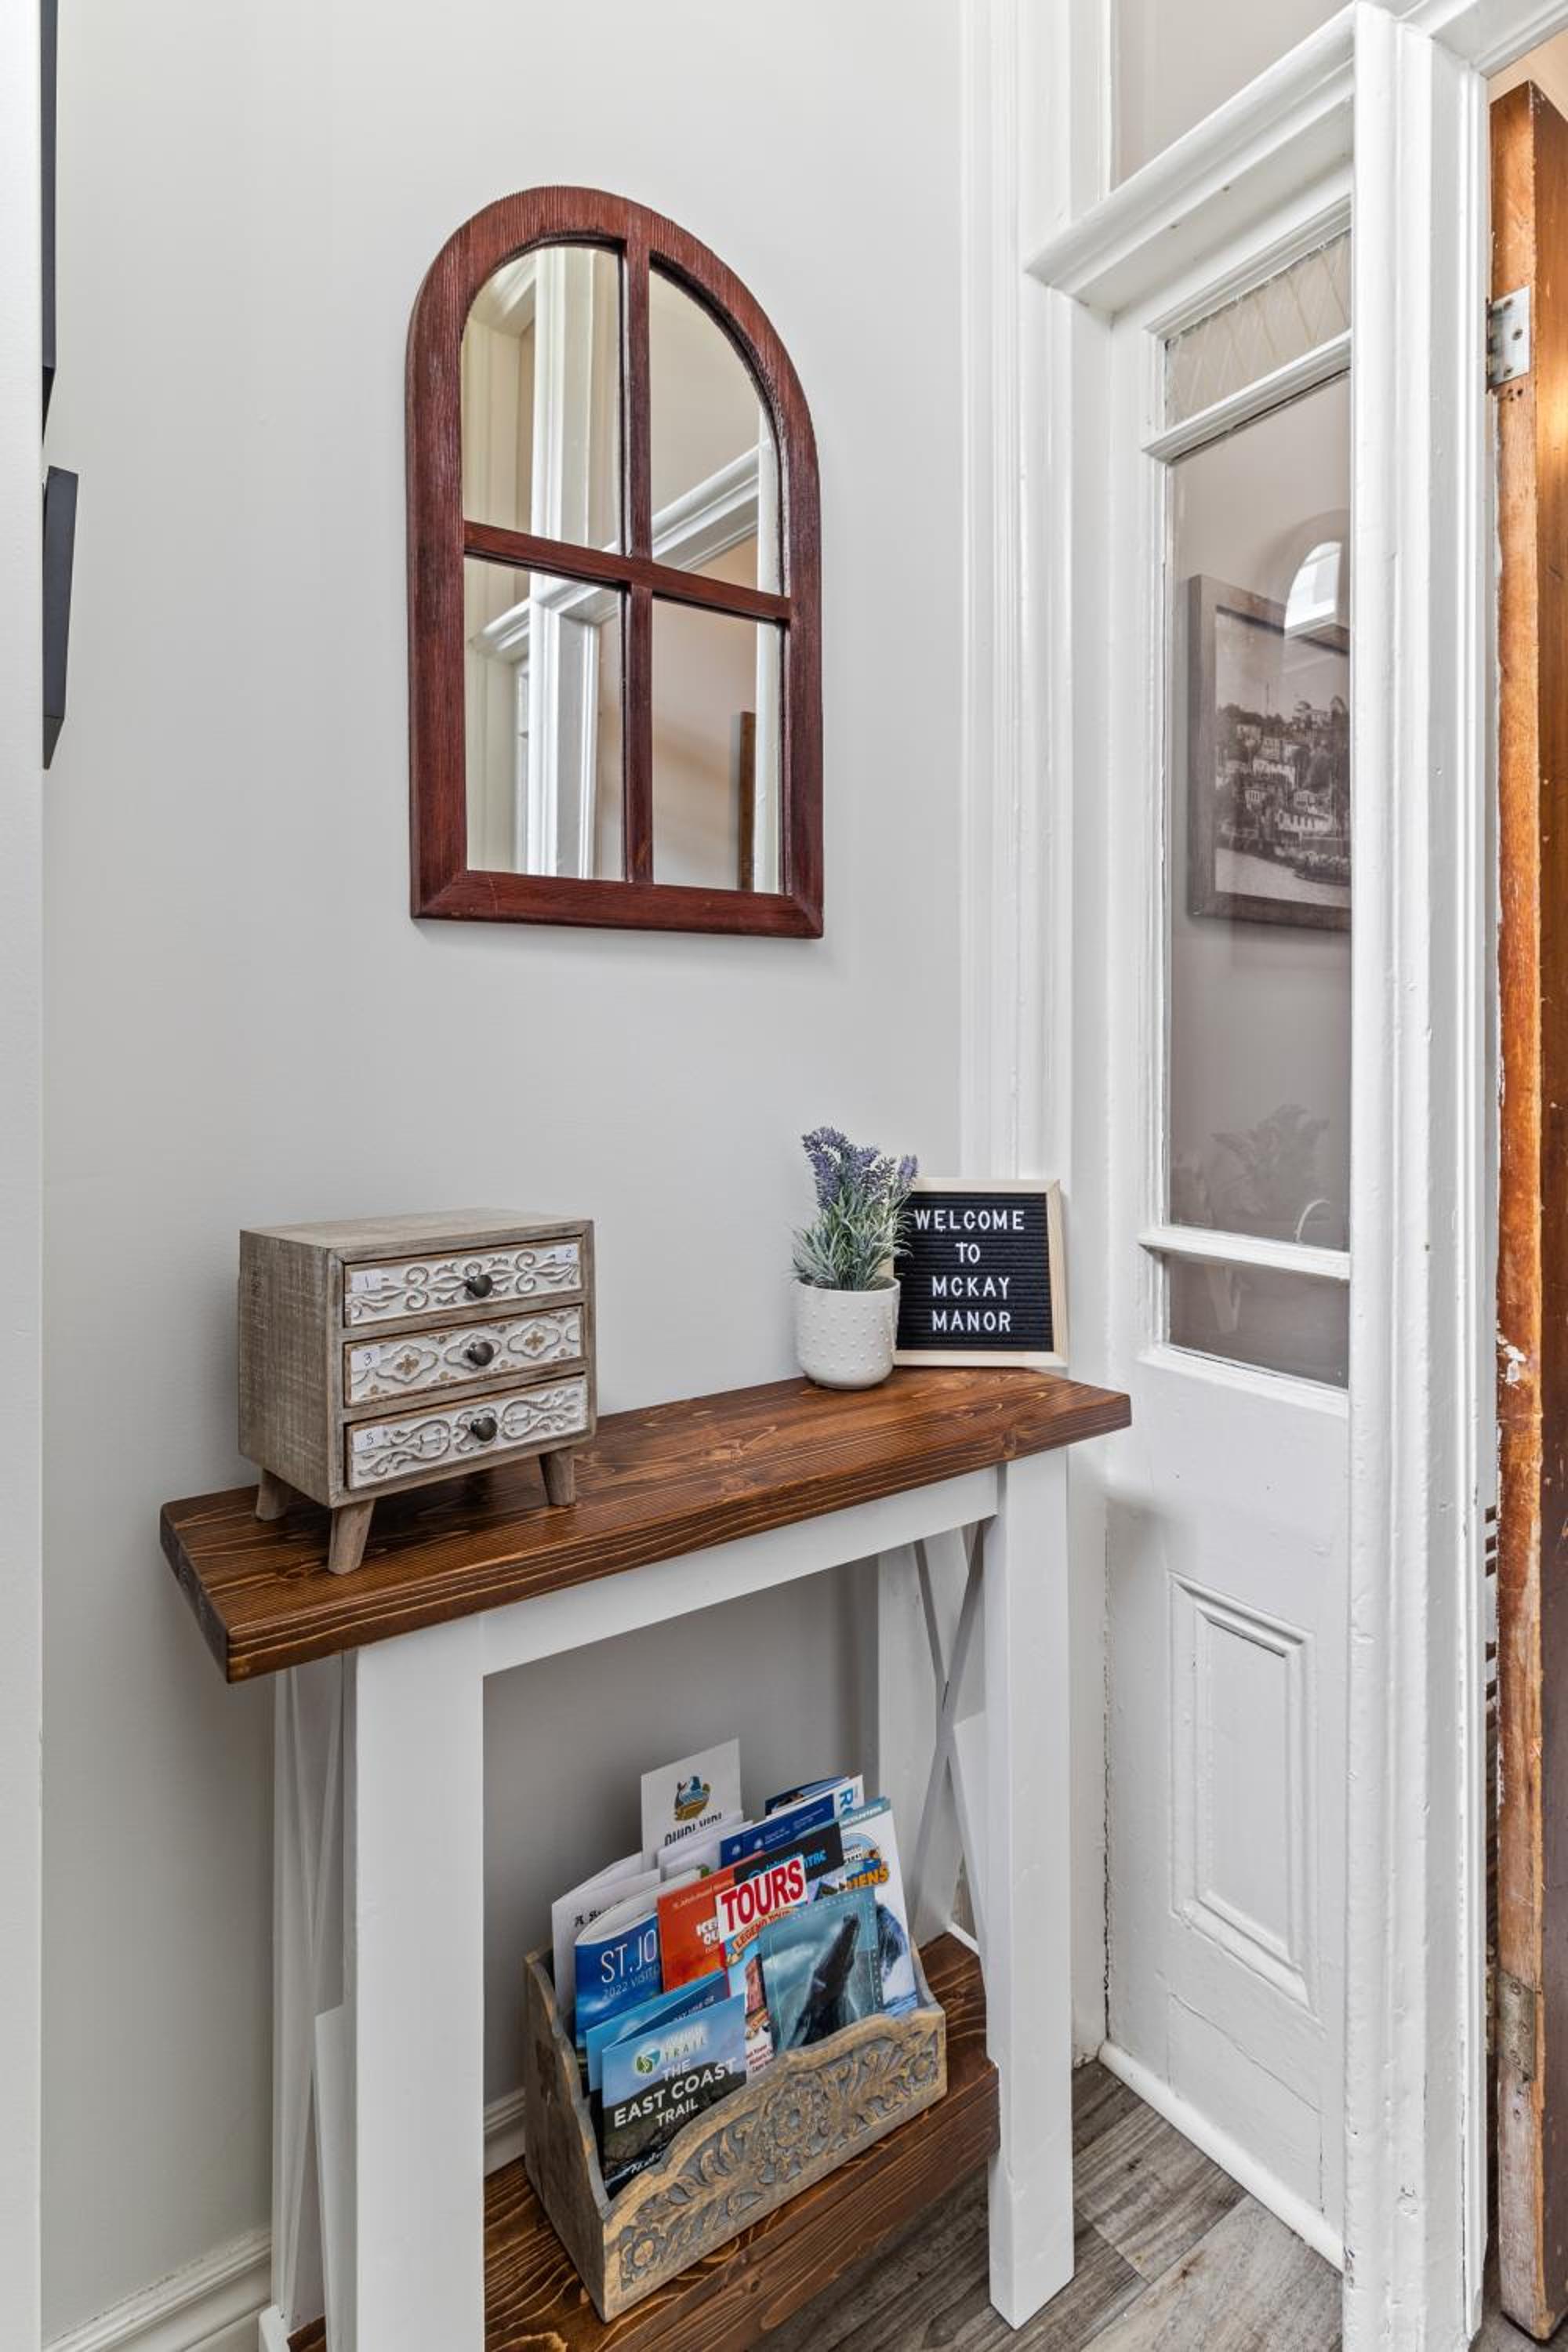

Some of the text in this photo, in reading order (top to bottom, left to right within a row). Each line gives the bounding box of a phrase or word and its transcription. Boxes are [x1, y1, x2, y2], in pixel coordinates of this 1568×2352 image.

[914, 1209, 1025, 1230] WELCOME
[954, 1241, 981, 1264] TO
[932, 1276, 1011, 1300] MCKAY
[932, 1310, 1011, 1332] MANOR
[720, 1859, 804, 1933] TOURS
[662, 2058, 691, 2082] THE
[614, 2089, 666, 2129] EAST
[670, 2056, 737, 2100] COAST
[655, 2097, 699, 2128] TRAIL
